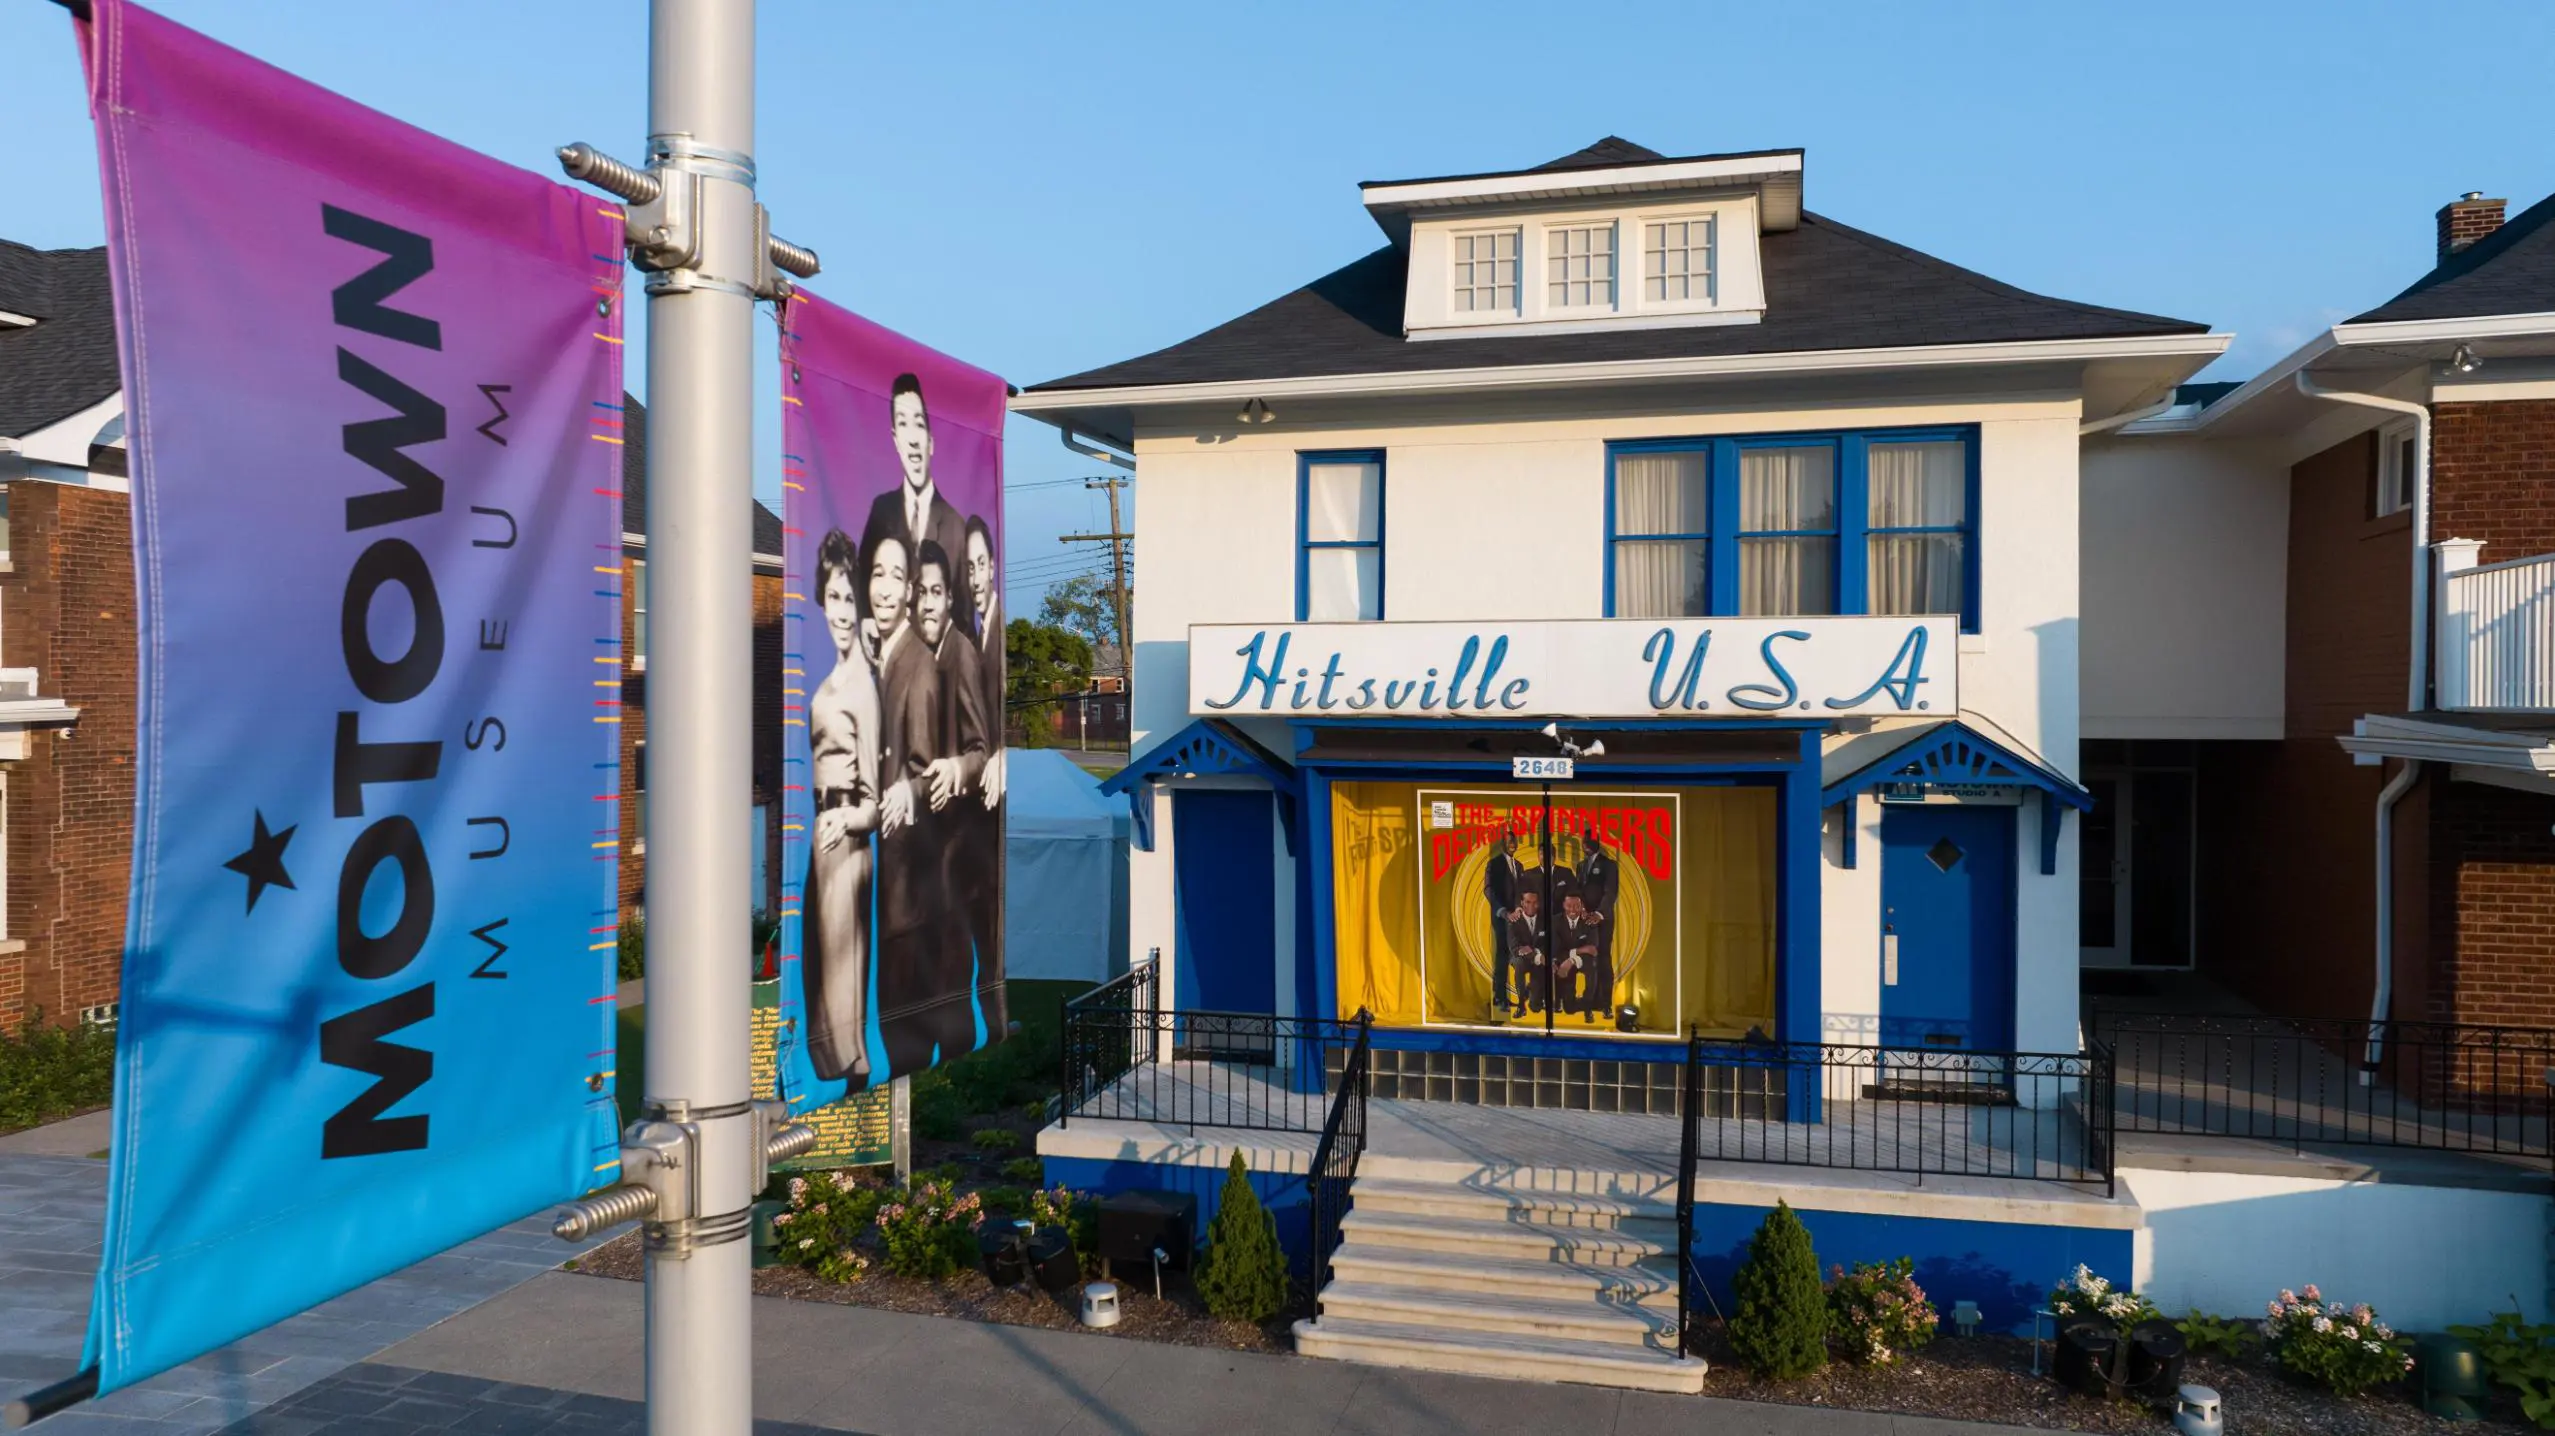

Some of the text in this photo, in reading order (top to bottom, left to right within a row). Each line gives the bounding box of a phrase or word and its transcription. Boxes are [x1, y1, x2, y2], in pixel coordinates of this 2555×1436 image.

[320, 202, 446, 1159] MOTOWN
[465, 383, 517, 980] MUSEUM
[1204, 631, 1531, 711] Hitsville
[1519, 760, 1568, 775] 2648
[1456, 803, 1504, 825] THE
[1511, 805, 1672, 881] SPINNERS
